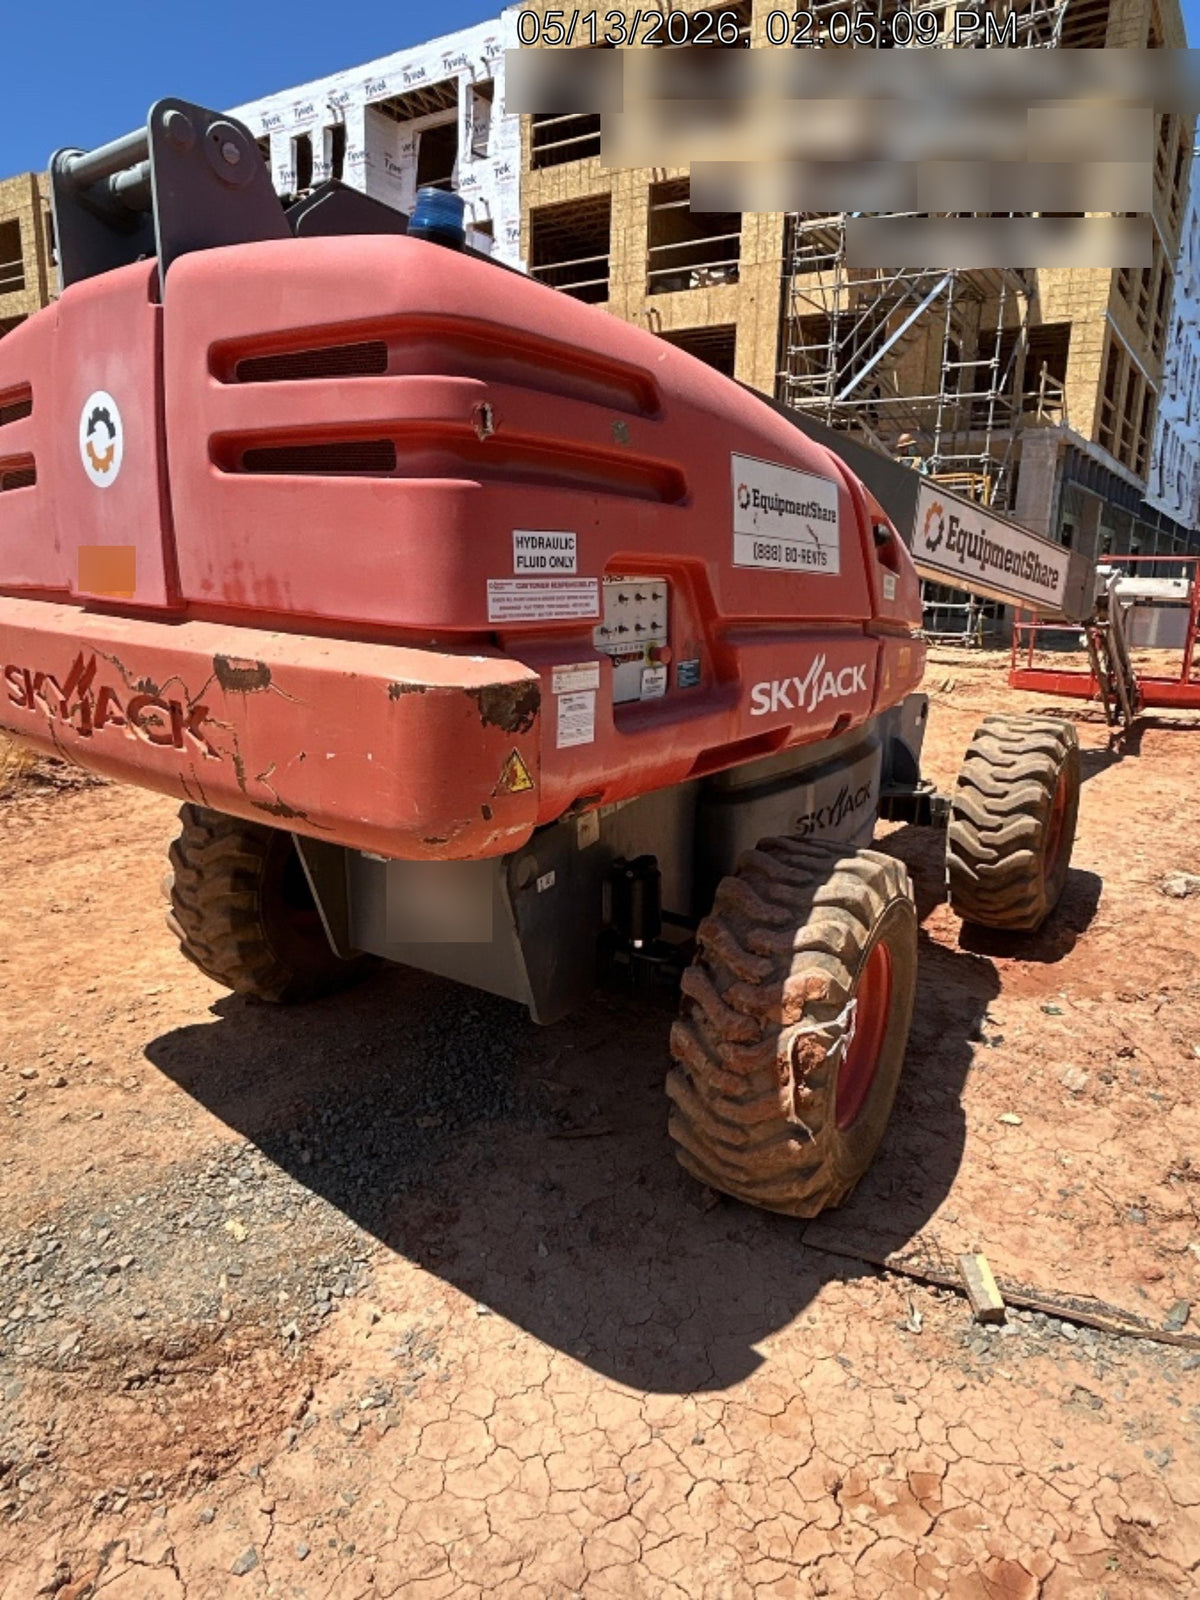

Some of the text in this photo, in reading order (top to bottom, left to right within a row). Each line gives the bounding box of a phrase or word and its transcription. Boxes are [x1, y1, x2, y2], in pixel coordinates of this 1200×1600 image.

[443, 53, 467, 70] Tyvek
[403, 67, 426, 84] Tyvek
[364, 80, 387, 96] Tyvek
[294, 103, 314, 118] Tyvek
[261, 115, 281, 129] Tyvek
[751, 488, 837, 525] EquipmentShare
[515, 536, 576, 551] HYDRAULIC
[752, 542, 782, 563] (888)
[945, 514, 1060, 591] EquipmentShare
[516, 555, 576, 569] FLUID ONLY
[750, 653, 868, 717] SKYJACK
[4, 650, 224, 763] SKYJACK
